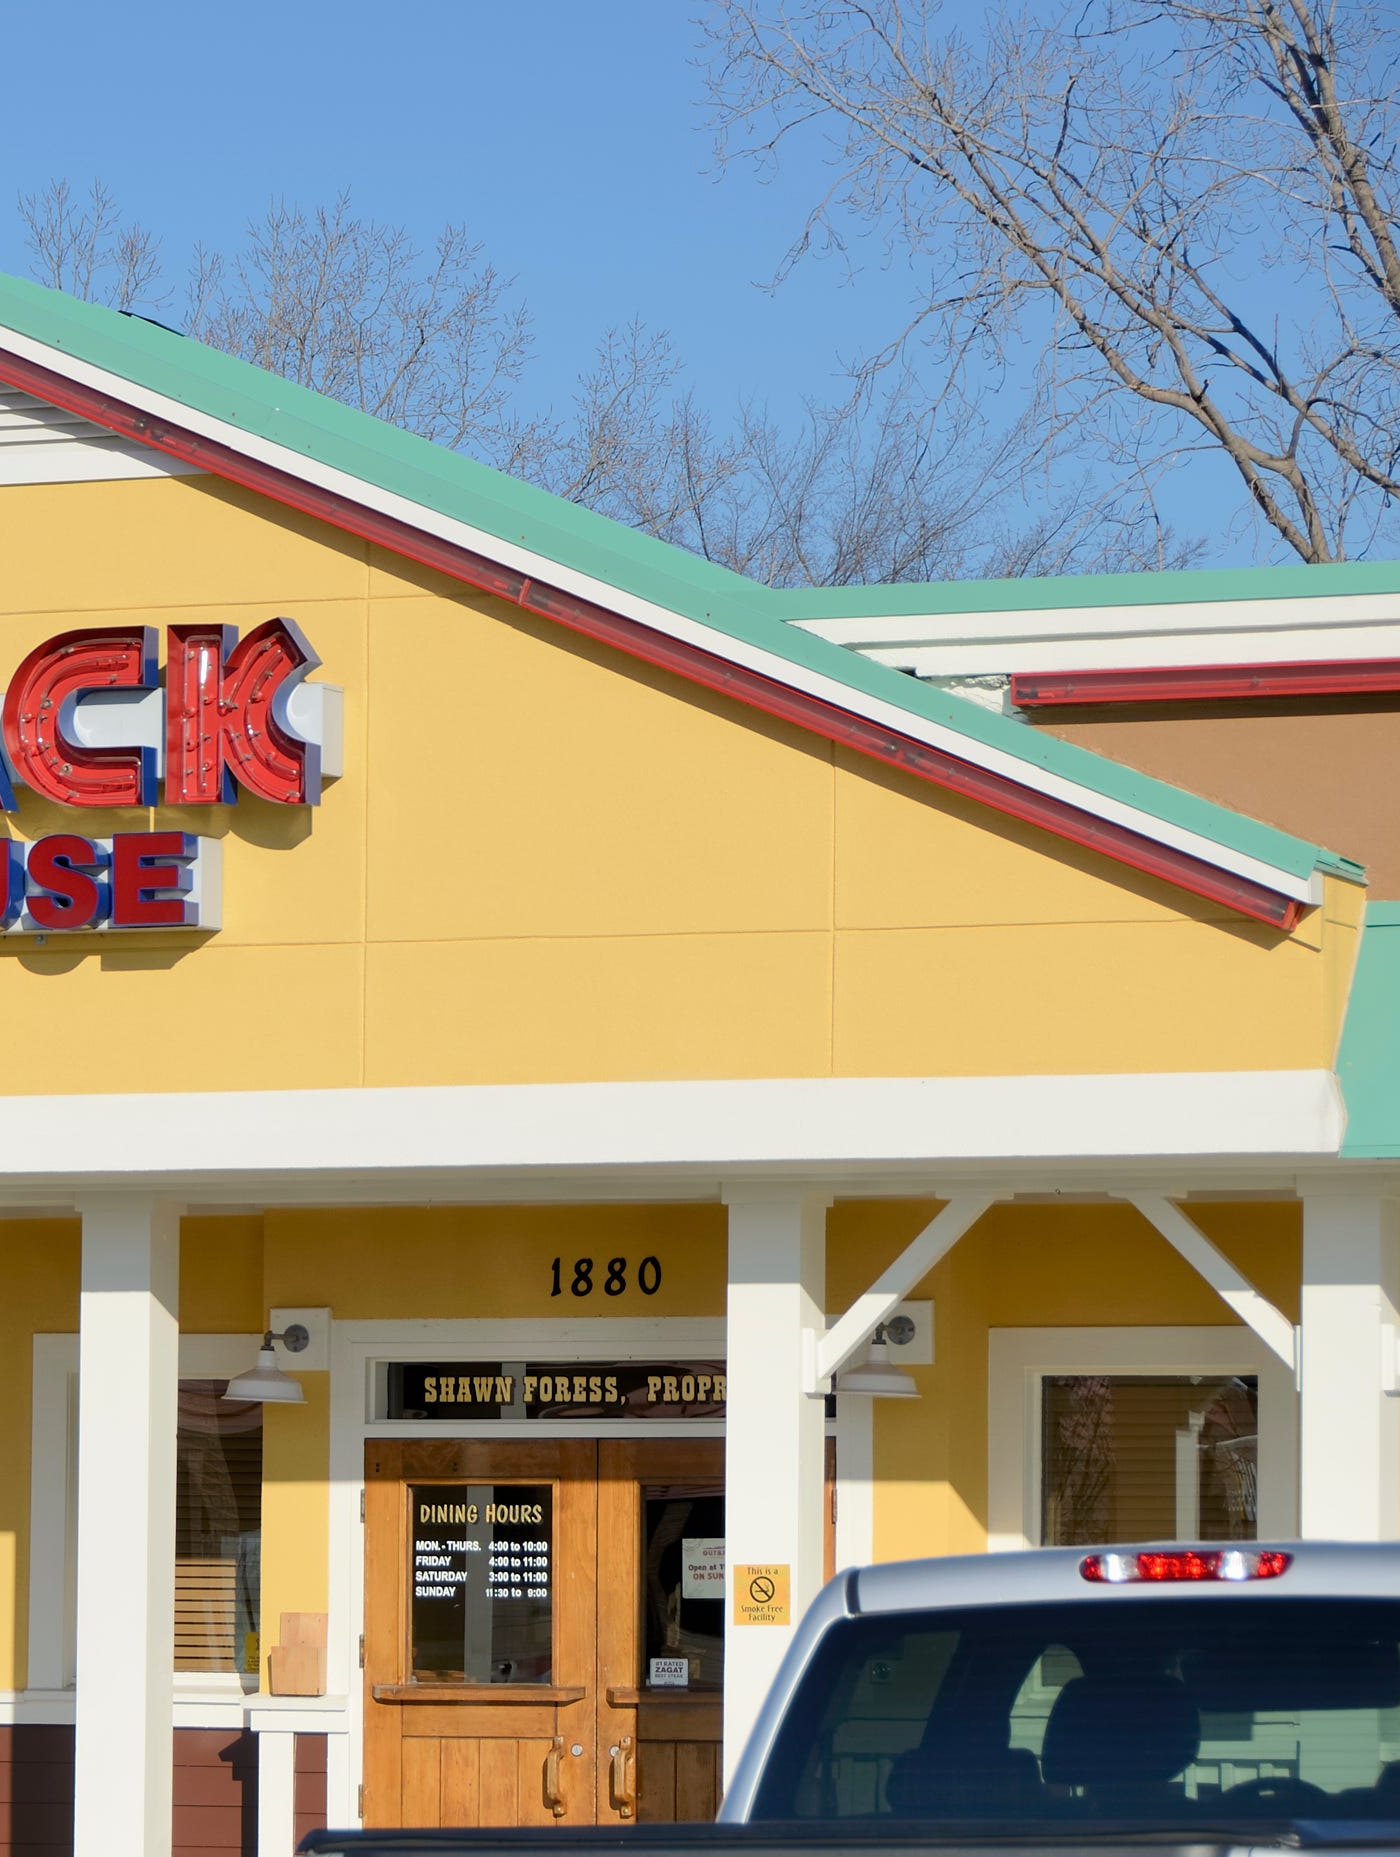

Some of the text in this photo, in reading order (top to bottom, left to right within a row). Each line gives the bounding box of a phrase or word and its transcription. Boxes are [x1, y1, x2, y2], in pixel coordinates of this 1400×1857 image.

[550, 1255, 662, 1297] 1880
[424, 1376, 513, 1403] SHAWN
[522, 1376, 626, 1405] FORESS,
[420, 1503, 543, 1524] DINING HOURS
[488, 1541, 509, 1552] 4:00
[510, 1541, 521, 1552] to
[522, 1541, 548, 1552] 10:00
[415, 1556, 548, 1567] FRIDAY 4:00 to 11:00
[688, 1564, 707, 1572] Open
[747, 1567, 763, 1575] This
[765, 1567, 771, 1575] is
[415, 1571, 548, 1582] SATURDAY 3:00 to 11:00
[693, 1572, 705, 1580] ON
[415, 1586, 547, 1597] SUNDAY 11:30 to 9:00
[741, 1605, 783, 1613] Smoke Free
[748, 1613, 776, 1622] Facility
